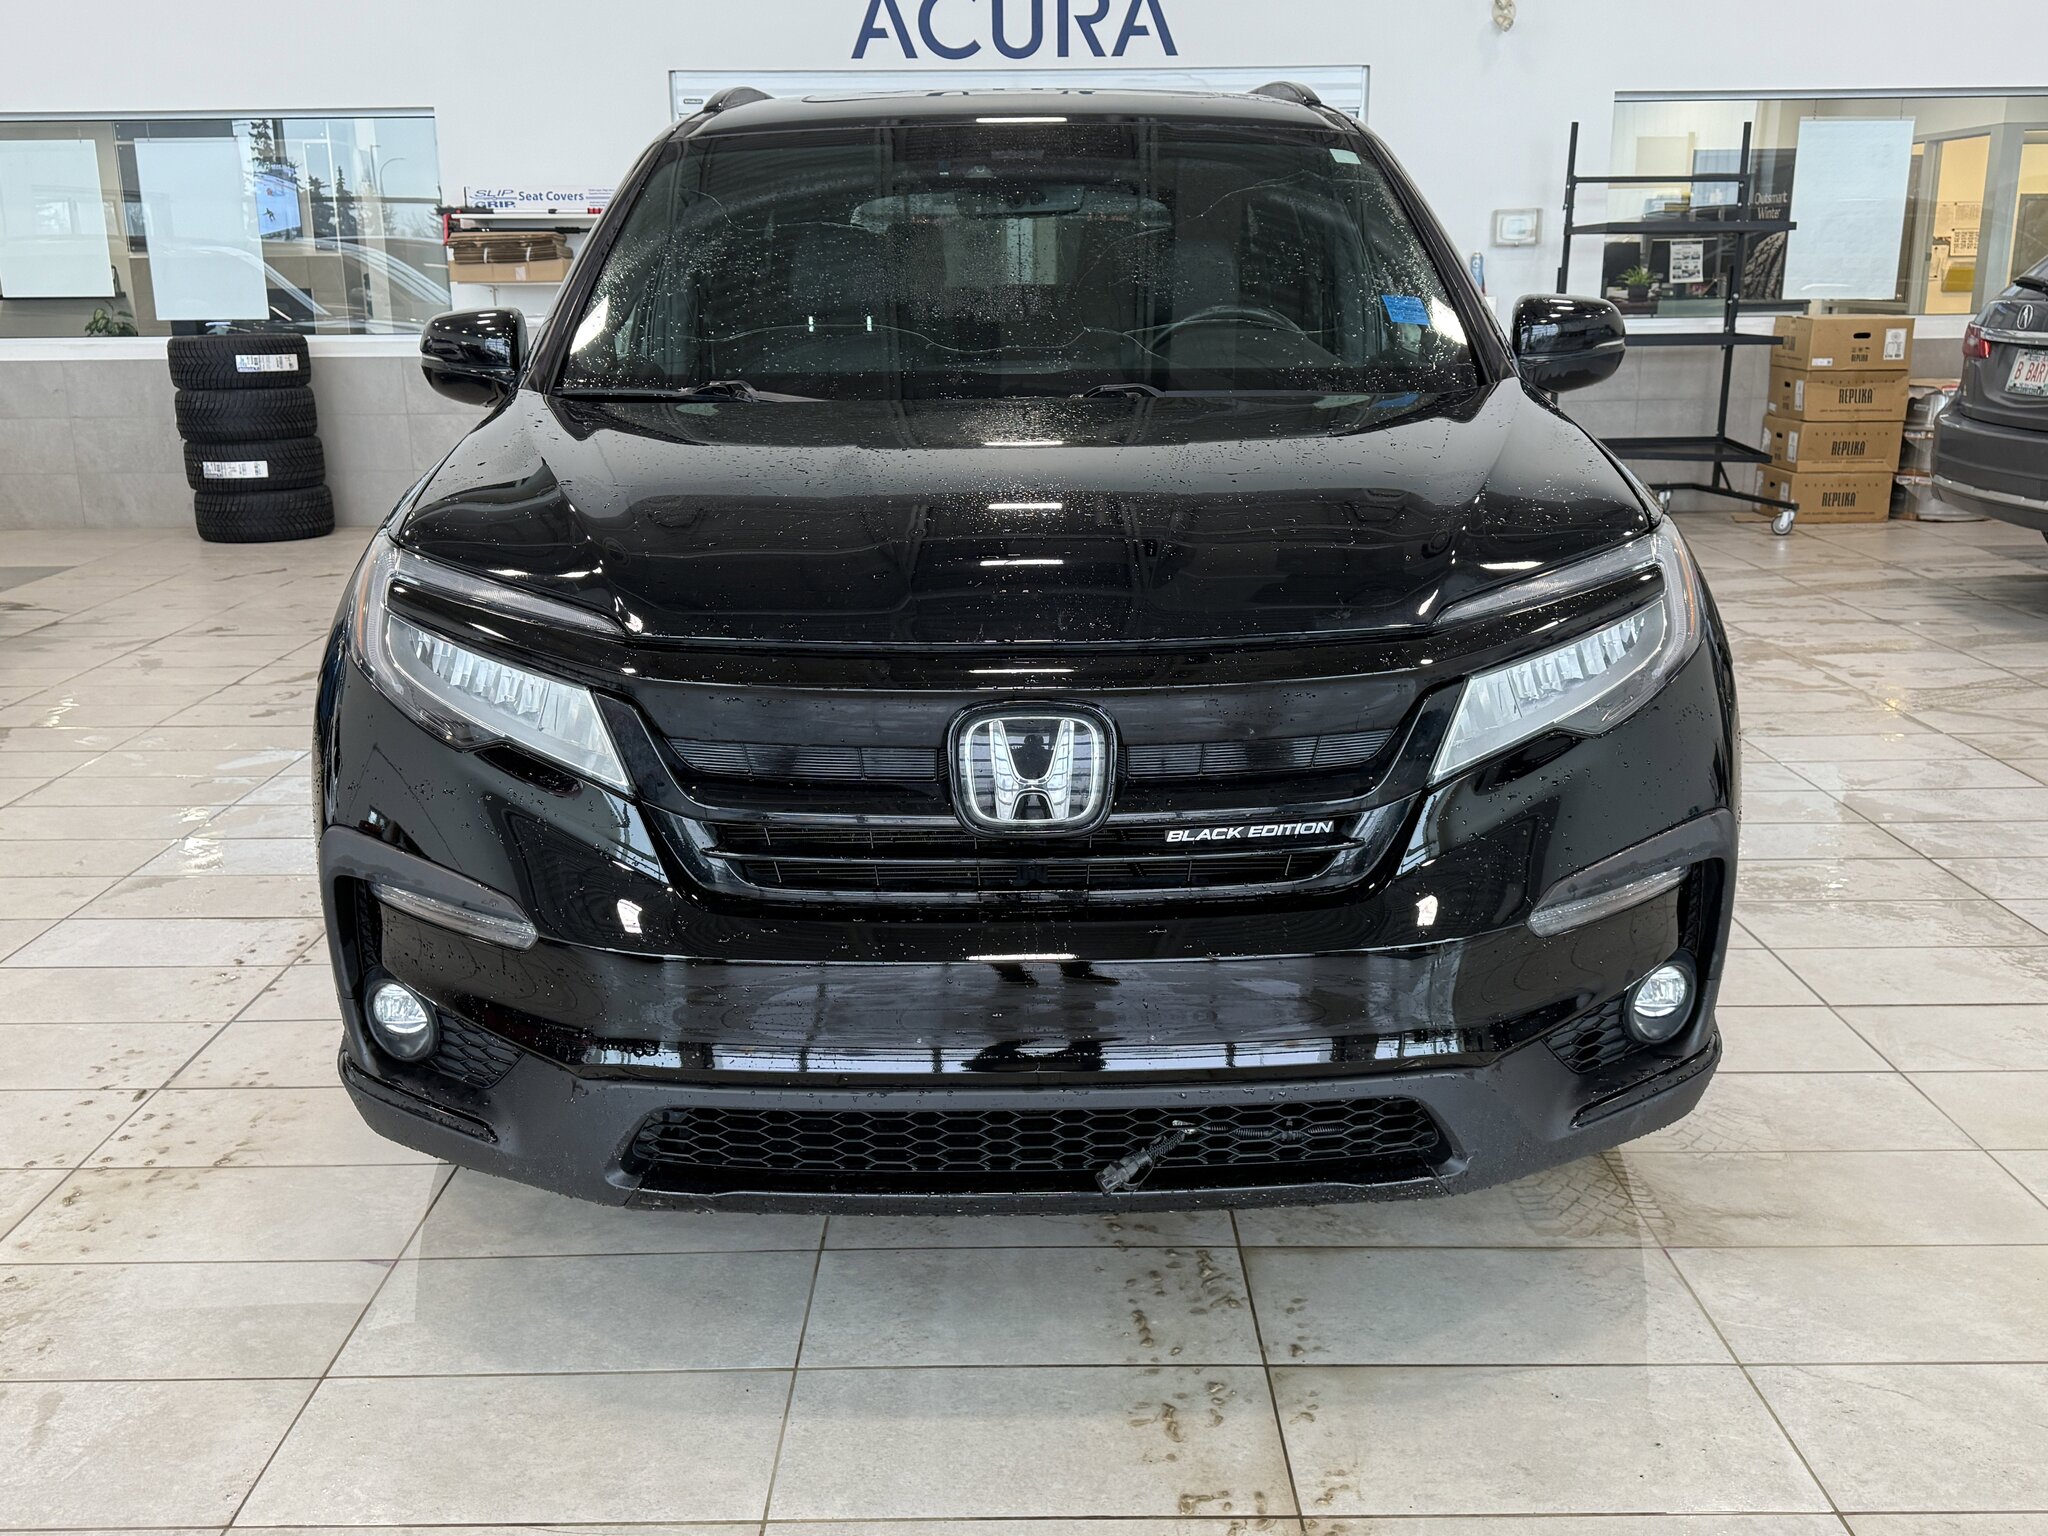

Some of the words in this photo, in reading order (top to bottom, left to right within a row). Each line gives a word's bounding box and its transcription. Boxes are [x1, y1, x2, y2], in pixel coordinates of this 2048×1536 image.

[851, 0, 1179, 60] ACURA
[474, 189, 515, 198] SLIP
[518, 191, 543, 201] Seat
[546, 191, 584, 201] Covers
[1754, 191, 1788, 205] Outsmart
[1757, 206, 1781, 219] Winter
[1838, 388, 1873, 404] REPLIKA
[1831, 441, 1866, 456] REPLIKA
[1821, 492, 1856, 507] REPLIKA
[1165, 826, 1245, 843] BLACK
[1247, 821, 1334, 838] EDITION
